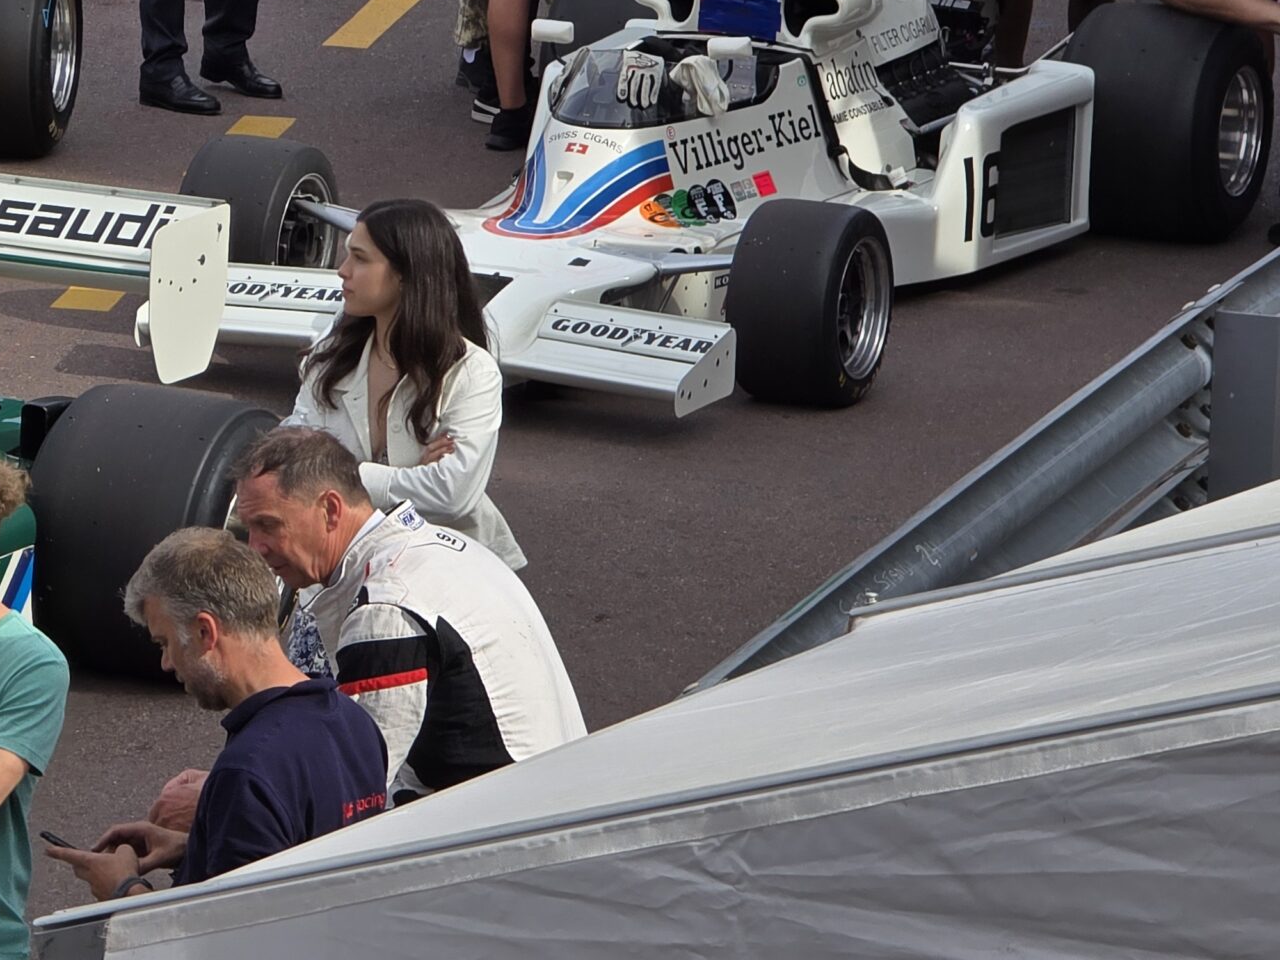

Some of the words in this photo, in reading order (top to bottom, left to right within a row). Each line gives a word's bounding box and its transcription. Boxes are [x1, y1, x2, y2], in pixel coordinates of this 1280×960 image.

[548, 130, 578, 144] SWISS
[583, 131, 624, 154] CIGARS
[668, 104, 822, 175] Villiger-Kiel
[227, 282, 343, 302] ODYEAR
[551, 317, 714, 354] GOODYEAR
